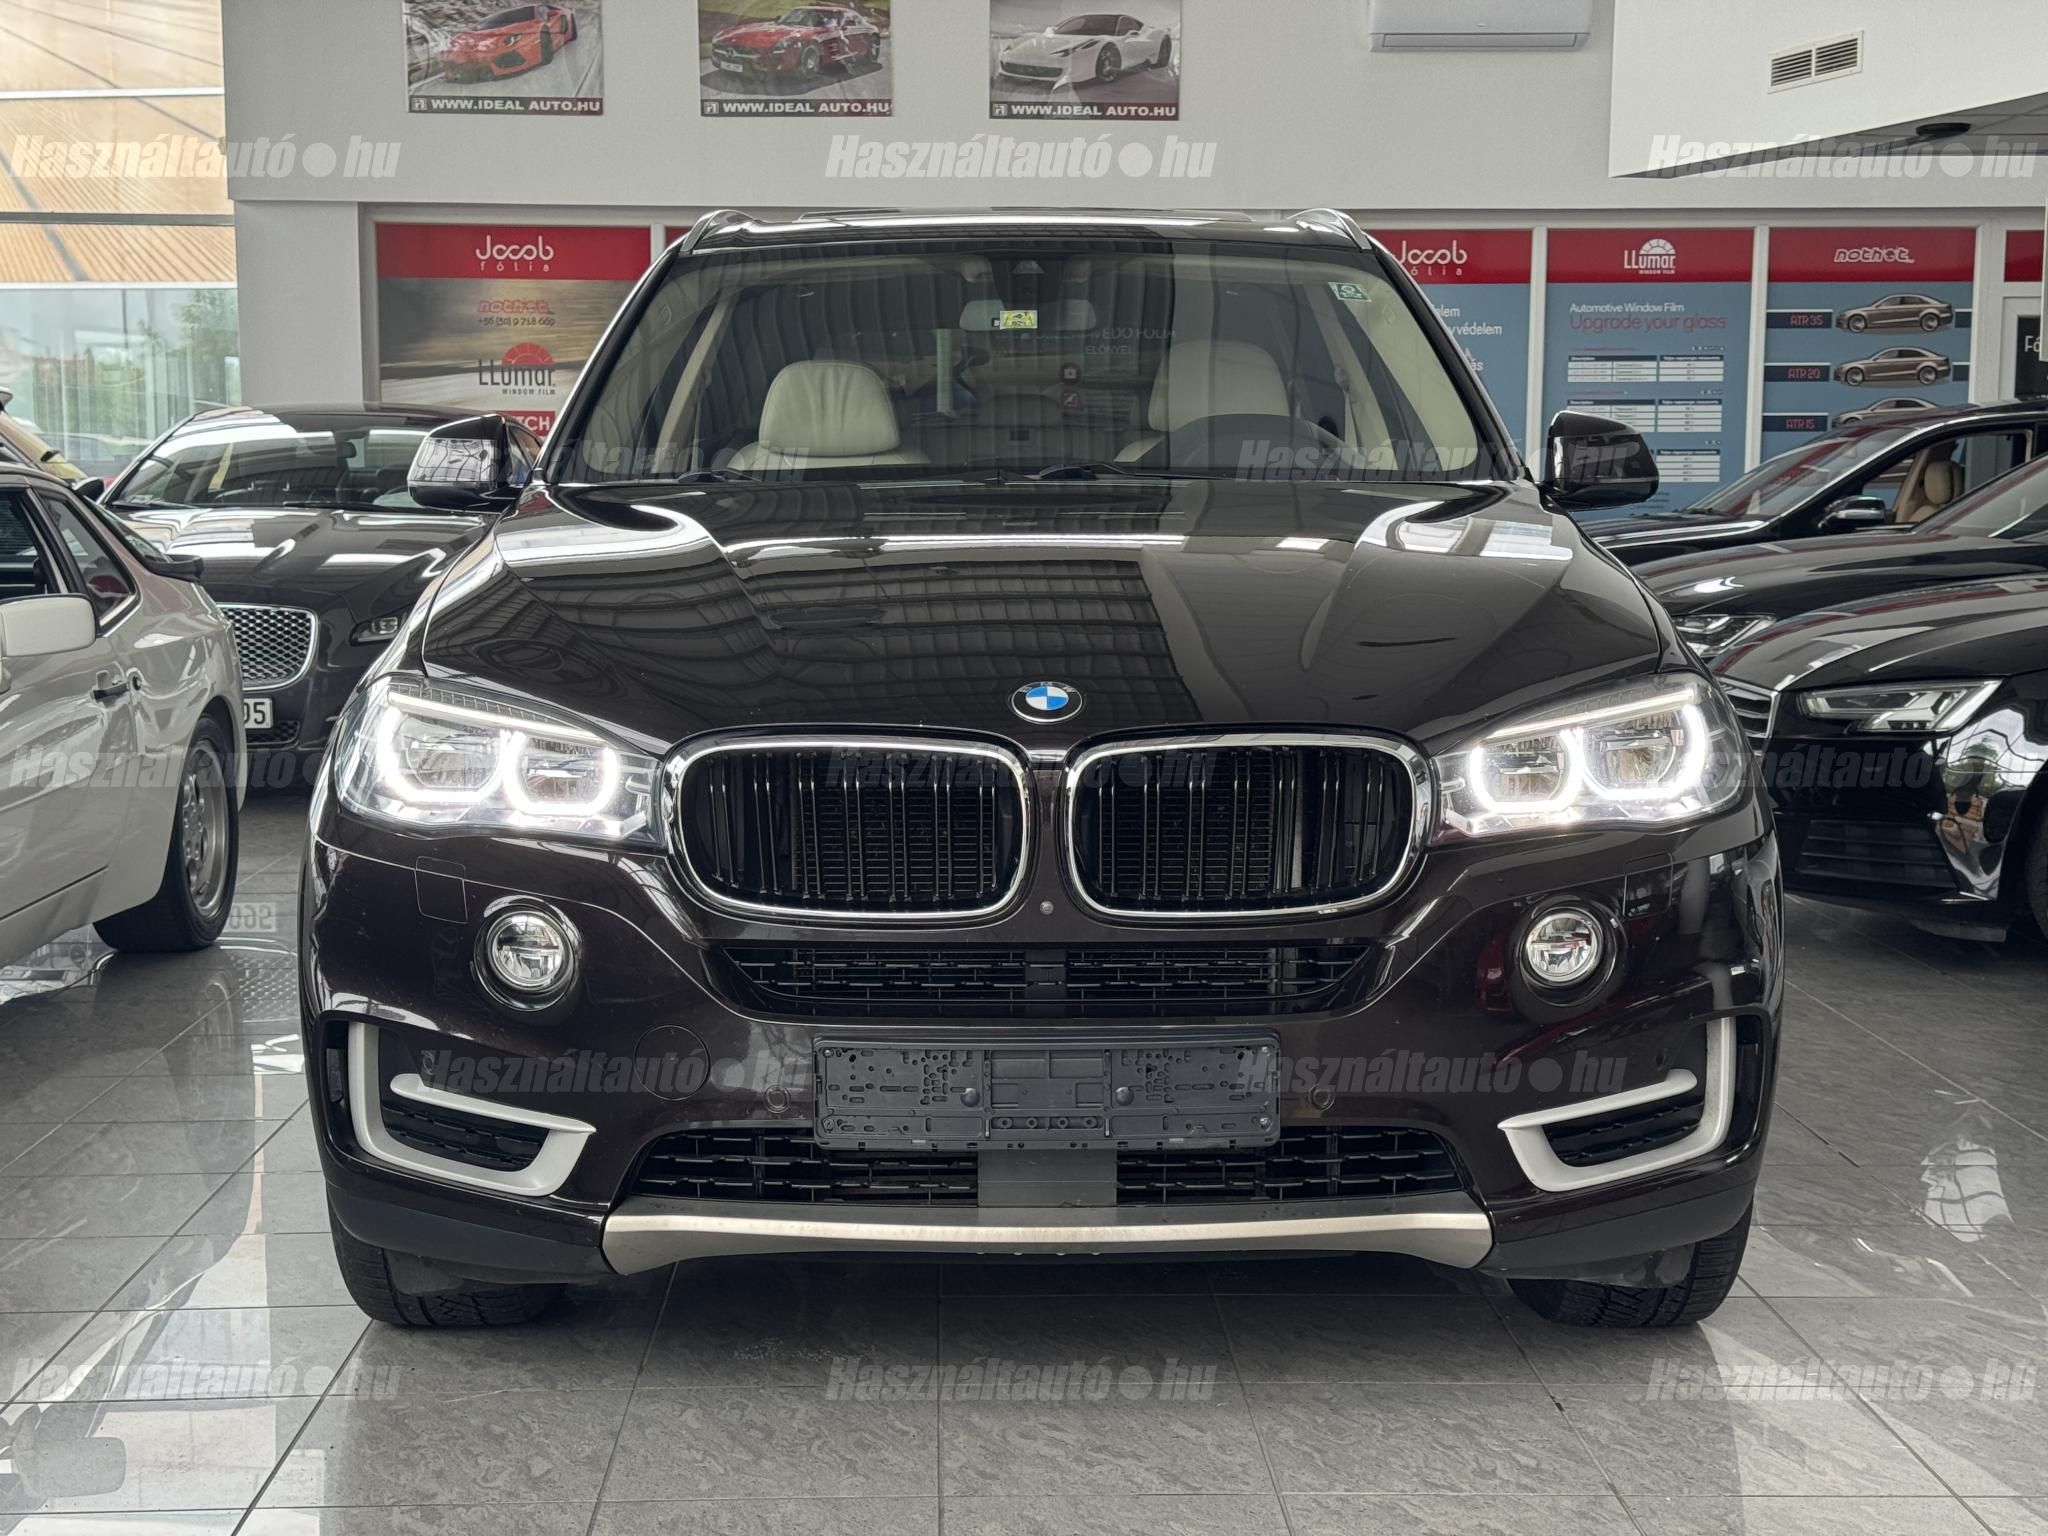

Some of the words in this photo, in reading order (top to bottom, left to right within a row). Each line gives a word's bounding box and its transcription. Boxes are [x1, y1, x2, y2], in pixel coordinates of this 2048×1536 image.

[431, 98, 525, 111] WWW.IDEAL
[528, 100, 601, 112] AUTO.HU
[723, 102, 815, 113] WWW.IDEAL
[818, 102, 889, 113] AUTO.HU
[1011, 104, 1102, 115] WWW.IDEAL
[1105, 105, 1176, 116] AUTO.HU
[1409, 265, 1463, 276] ólia
[1570, 303, 1623, 313] Automotive
[1624, 303, 1663, 312] Window
[1664, 302, 1685, 312] Film
[1570, 315, 1642, 334] Upgrade
[1644, 318, 1681, 334] your
[1683, 314, 1727, 333] glass
[1790, 315, 1809, 326] ATR
